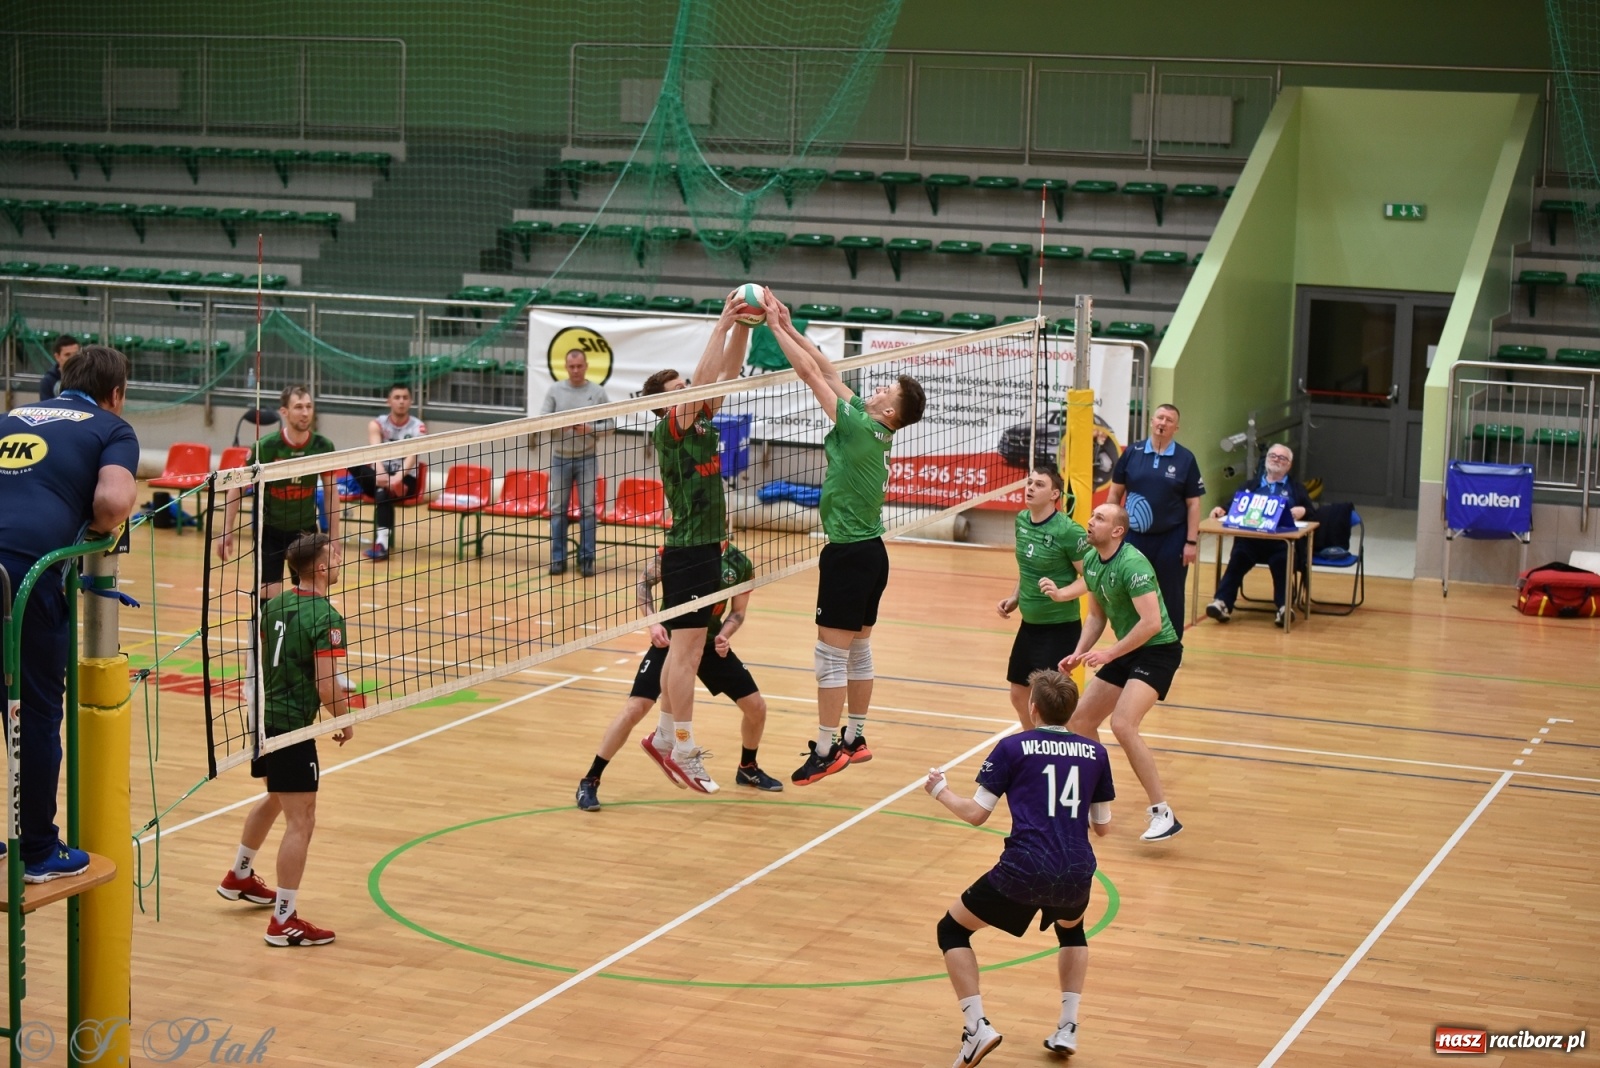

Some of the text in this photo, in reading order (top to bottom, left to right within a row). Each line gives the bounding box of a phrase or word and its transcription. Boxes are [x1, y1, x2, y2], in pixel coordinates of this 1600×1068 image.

[0, 441, 40, 461] HK
[918, 464, 950, 484] 496
[953, 467, 988, 487] 555
[1007, 491, 1023, 504] 45
[1461, 492, 1521, 509] molten
[1026, 543, 1034, 559] 3
[273, 620, 287, 668] 7
[640, 659, 651, 674] 3
[1021, 739, 1097, 763] WŁODOWICE
[1041, 763, 1082, 820] 14
